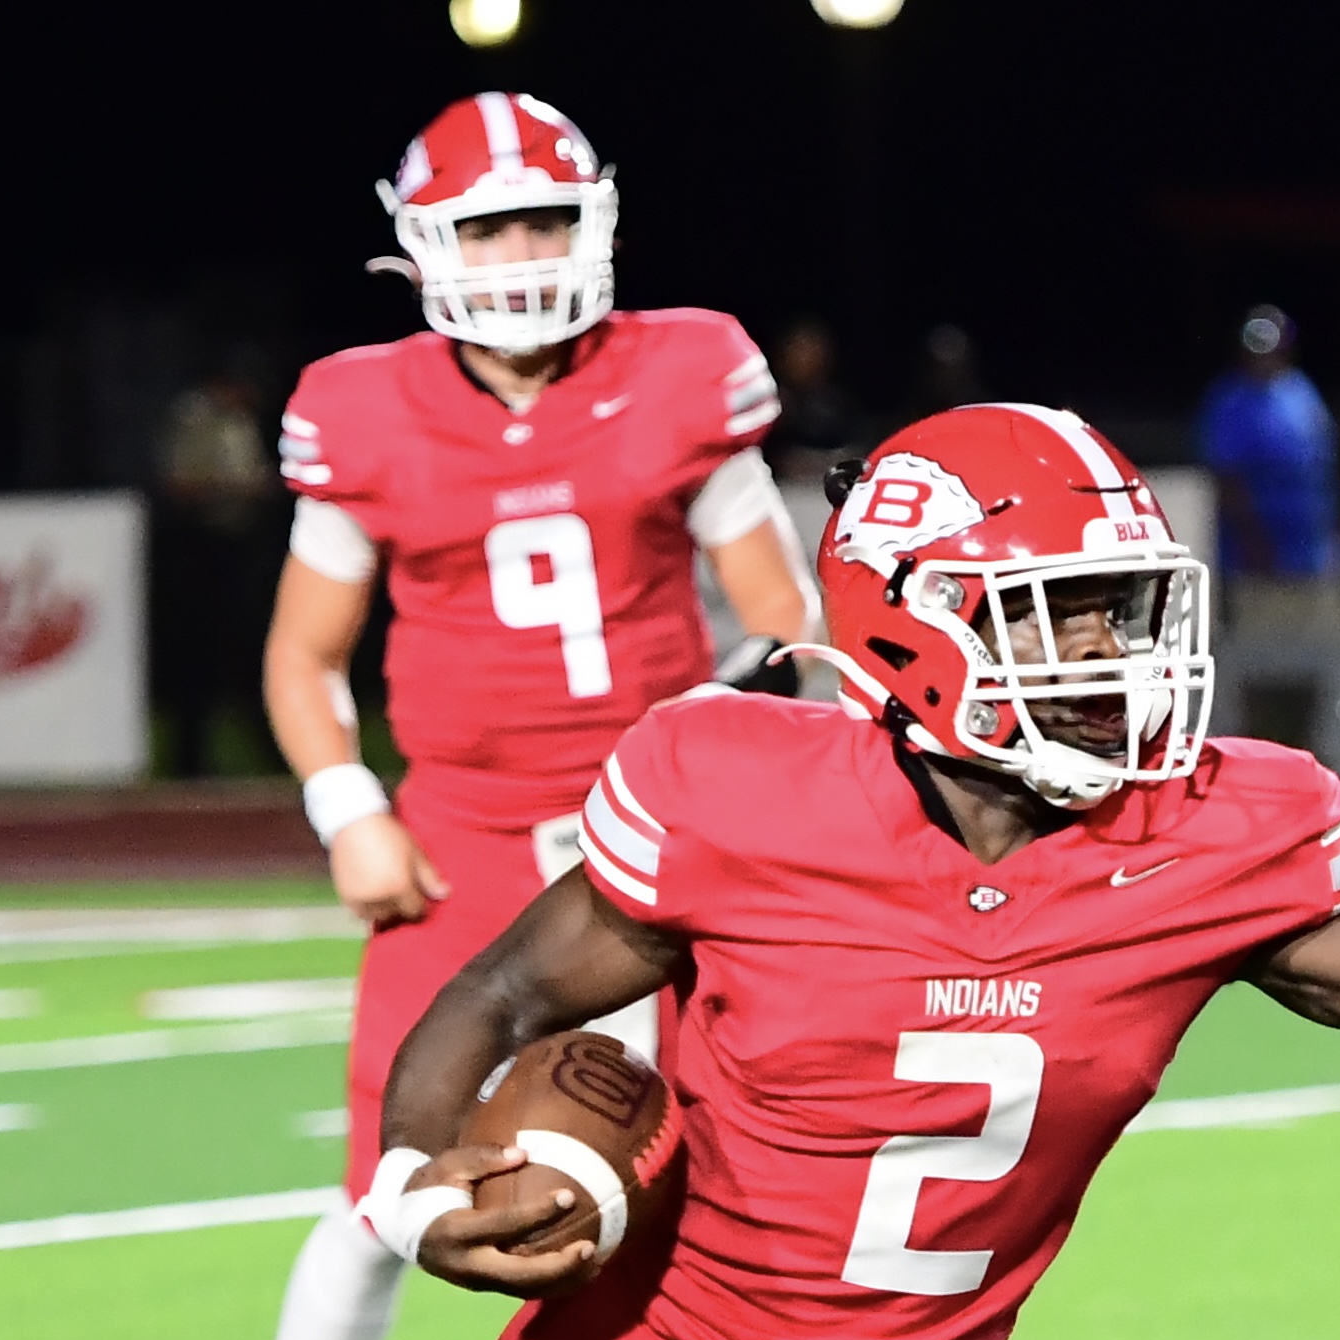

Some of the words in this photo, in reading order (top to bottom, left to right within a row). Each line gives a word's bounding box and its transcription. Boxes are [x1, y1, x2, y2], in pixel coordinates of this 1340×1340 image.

[859, 478, 933, 528] B
[484, 512, 613, 698] 9
[925, 979, 1043, 1017] INDIANS
[840, 1031, 1044, 1296] 2
